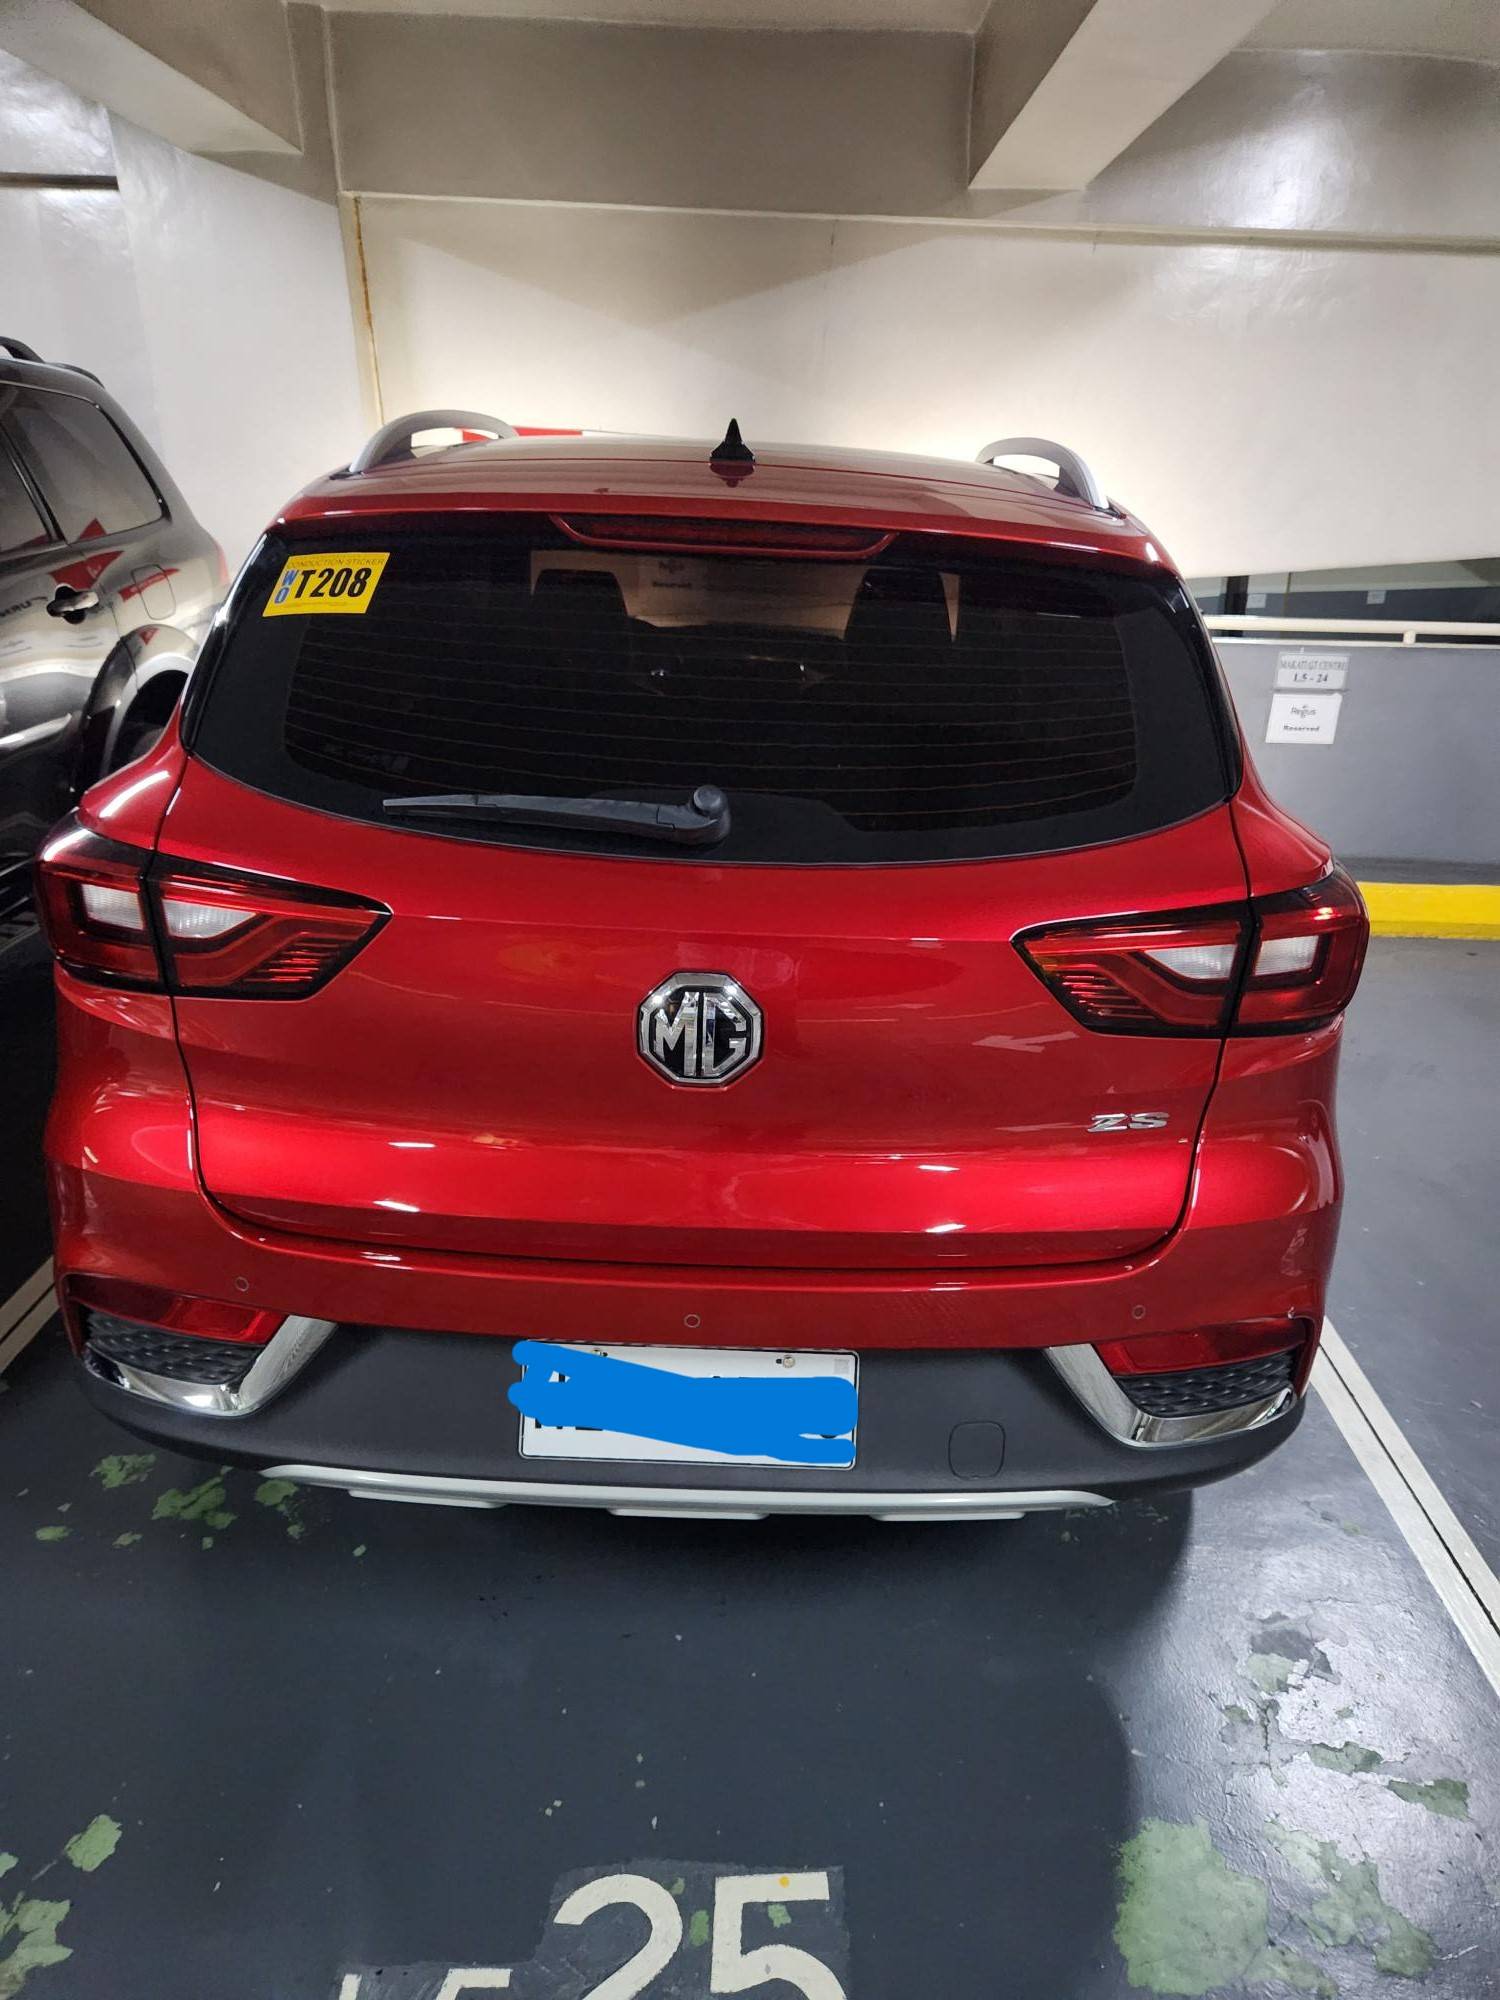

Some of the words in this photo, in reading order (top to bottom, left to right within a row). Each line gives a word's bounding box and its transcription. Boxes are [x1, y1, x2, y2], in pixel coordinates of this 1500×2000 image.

[346, 558, 385, 566] STICKER
[294, 567, 372, 599] T208
[653, 991, 748, 1076] MG
[1087, 1111, 1170, 1133] ZS
